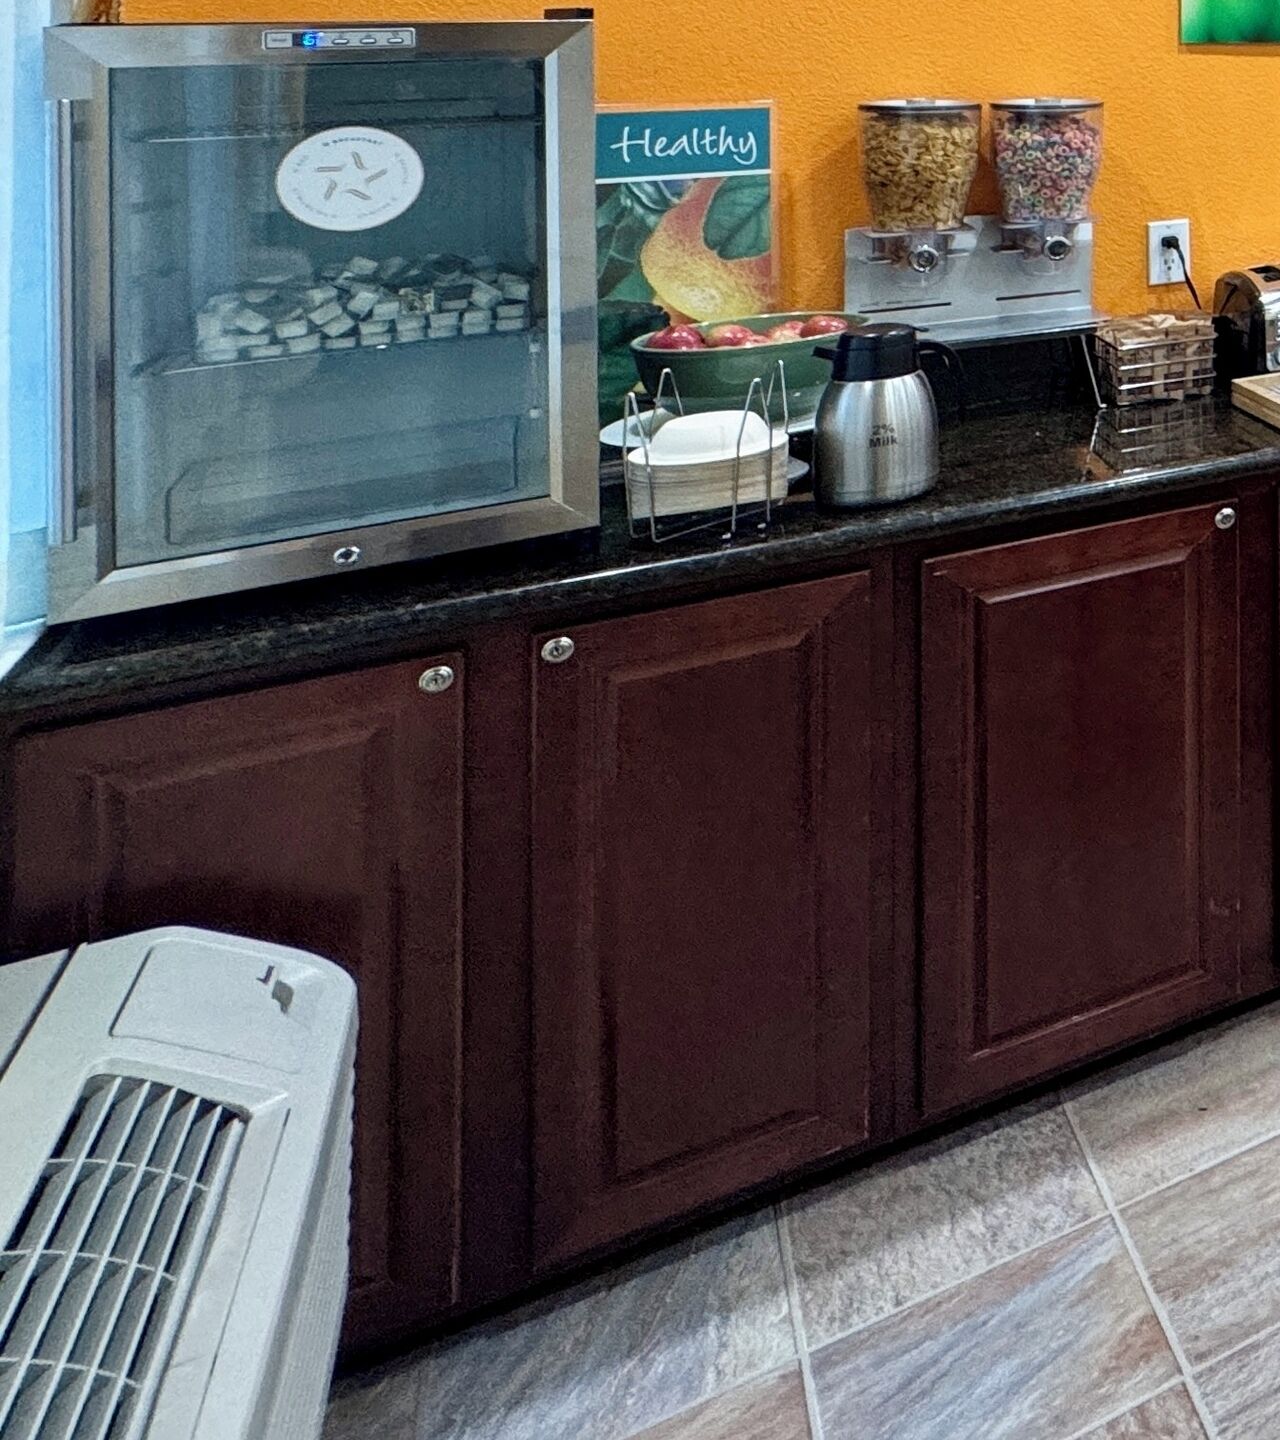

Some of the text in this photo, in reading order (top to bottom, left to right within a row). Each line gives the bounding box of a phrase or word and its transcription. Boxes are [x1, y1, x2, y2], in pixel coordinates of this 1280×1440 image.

[610, 125, 757, 165] Healthy
[872, 423, 895, 436] 2%
[869, 435, 898, 448] Milk
